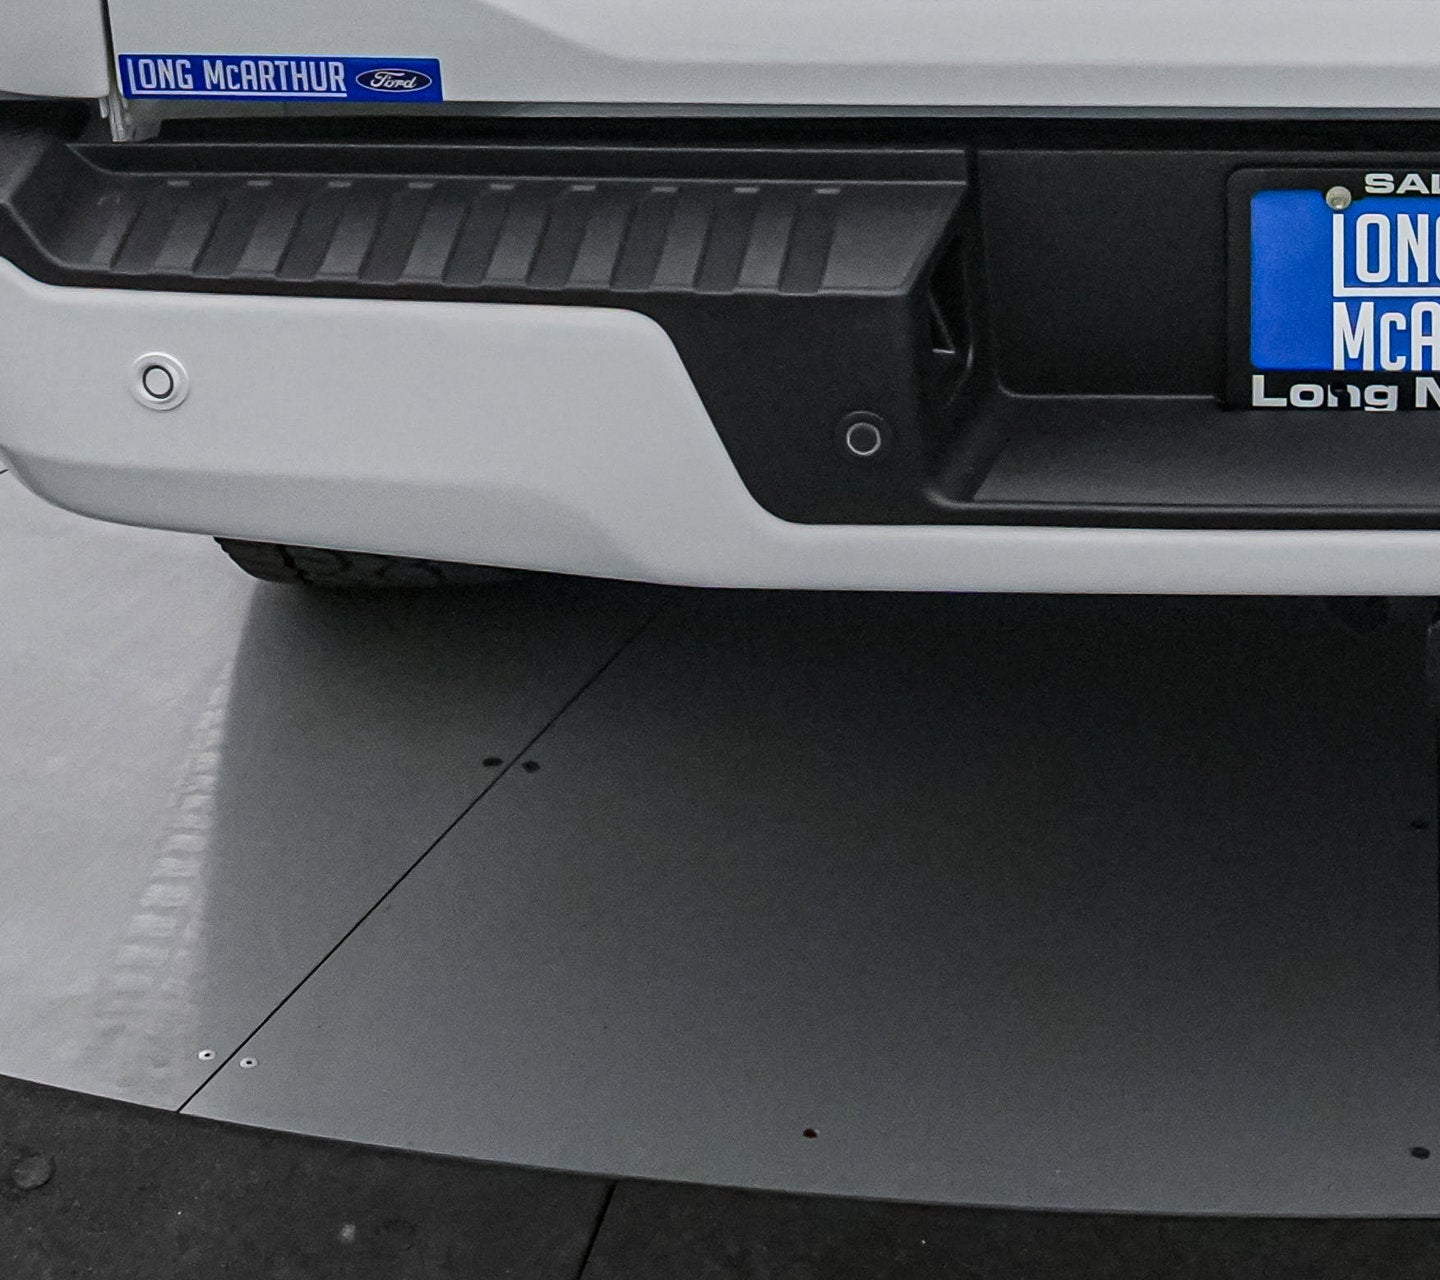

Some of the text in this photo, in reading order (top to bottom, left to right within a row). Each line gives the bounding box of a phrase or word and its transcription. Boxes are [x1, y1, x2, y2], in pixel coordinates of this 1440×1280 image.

[127, 57, 347, 94] LONG McARTHUR
[369, 71, 418, 90] Ford
[1251, 374, 1400, 412] Long
